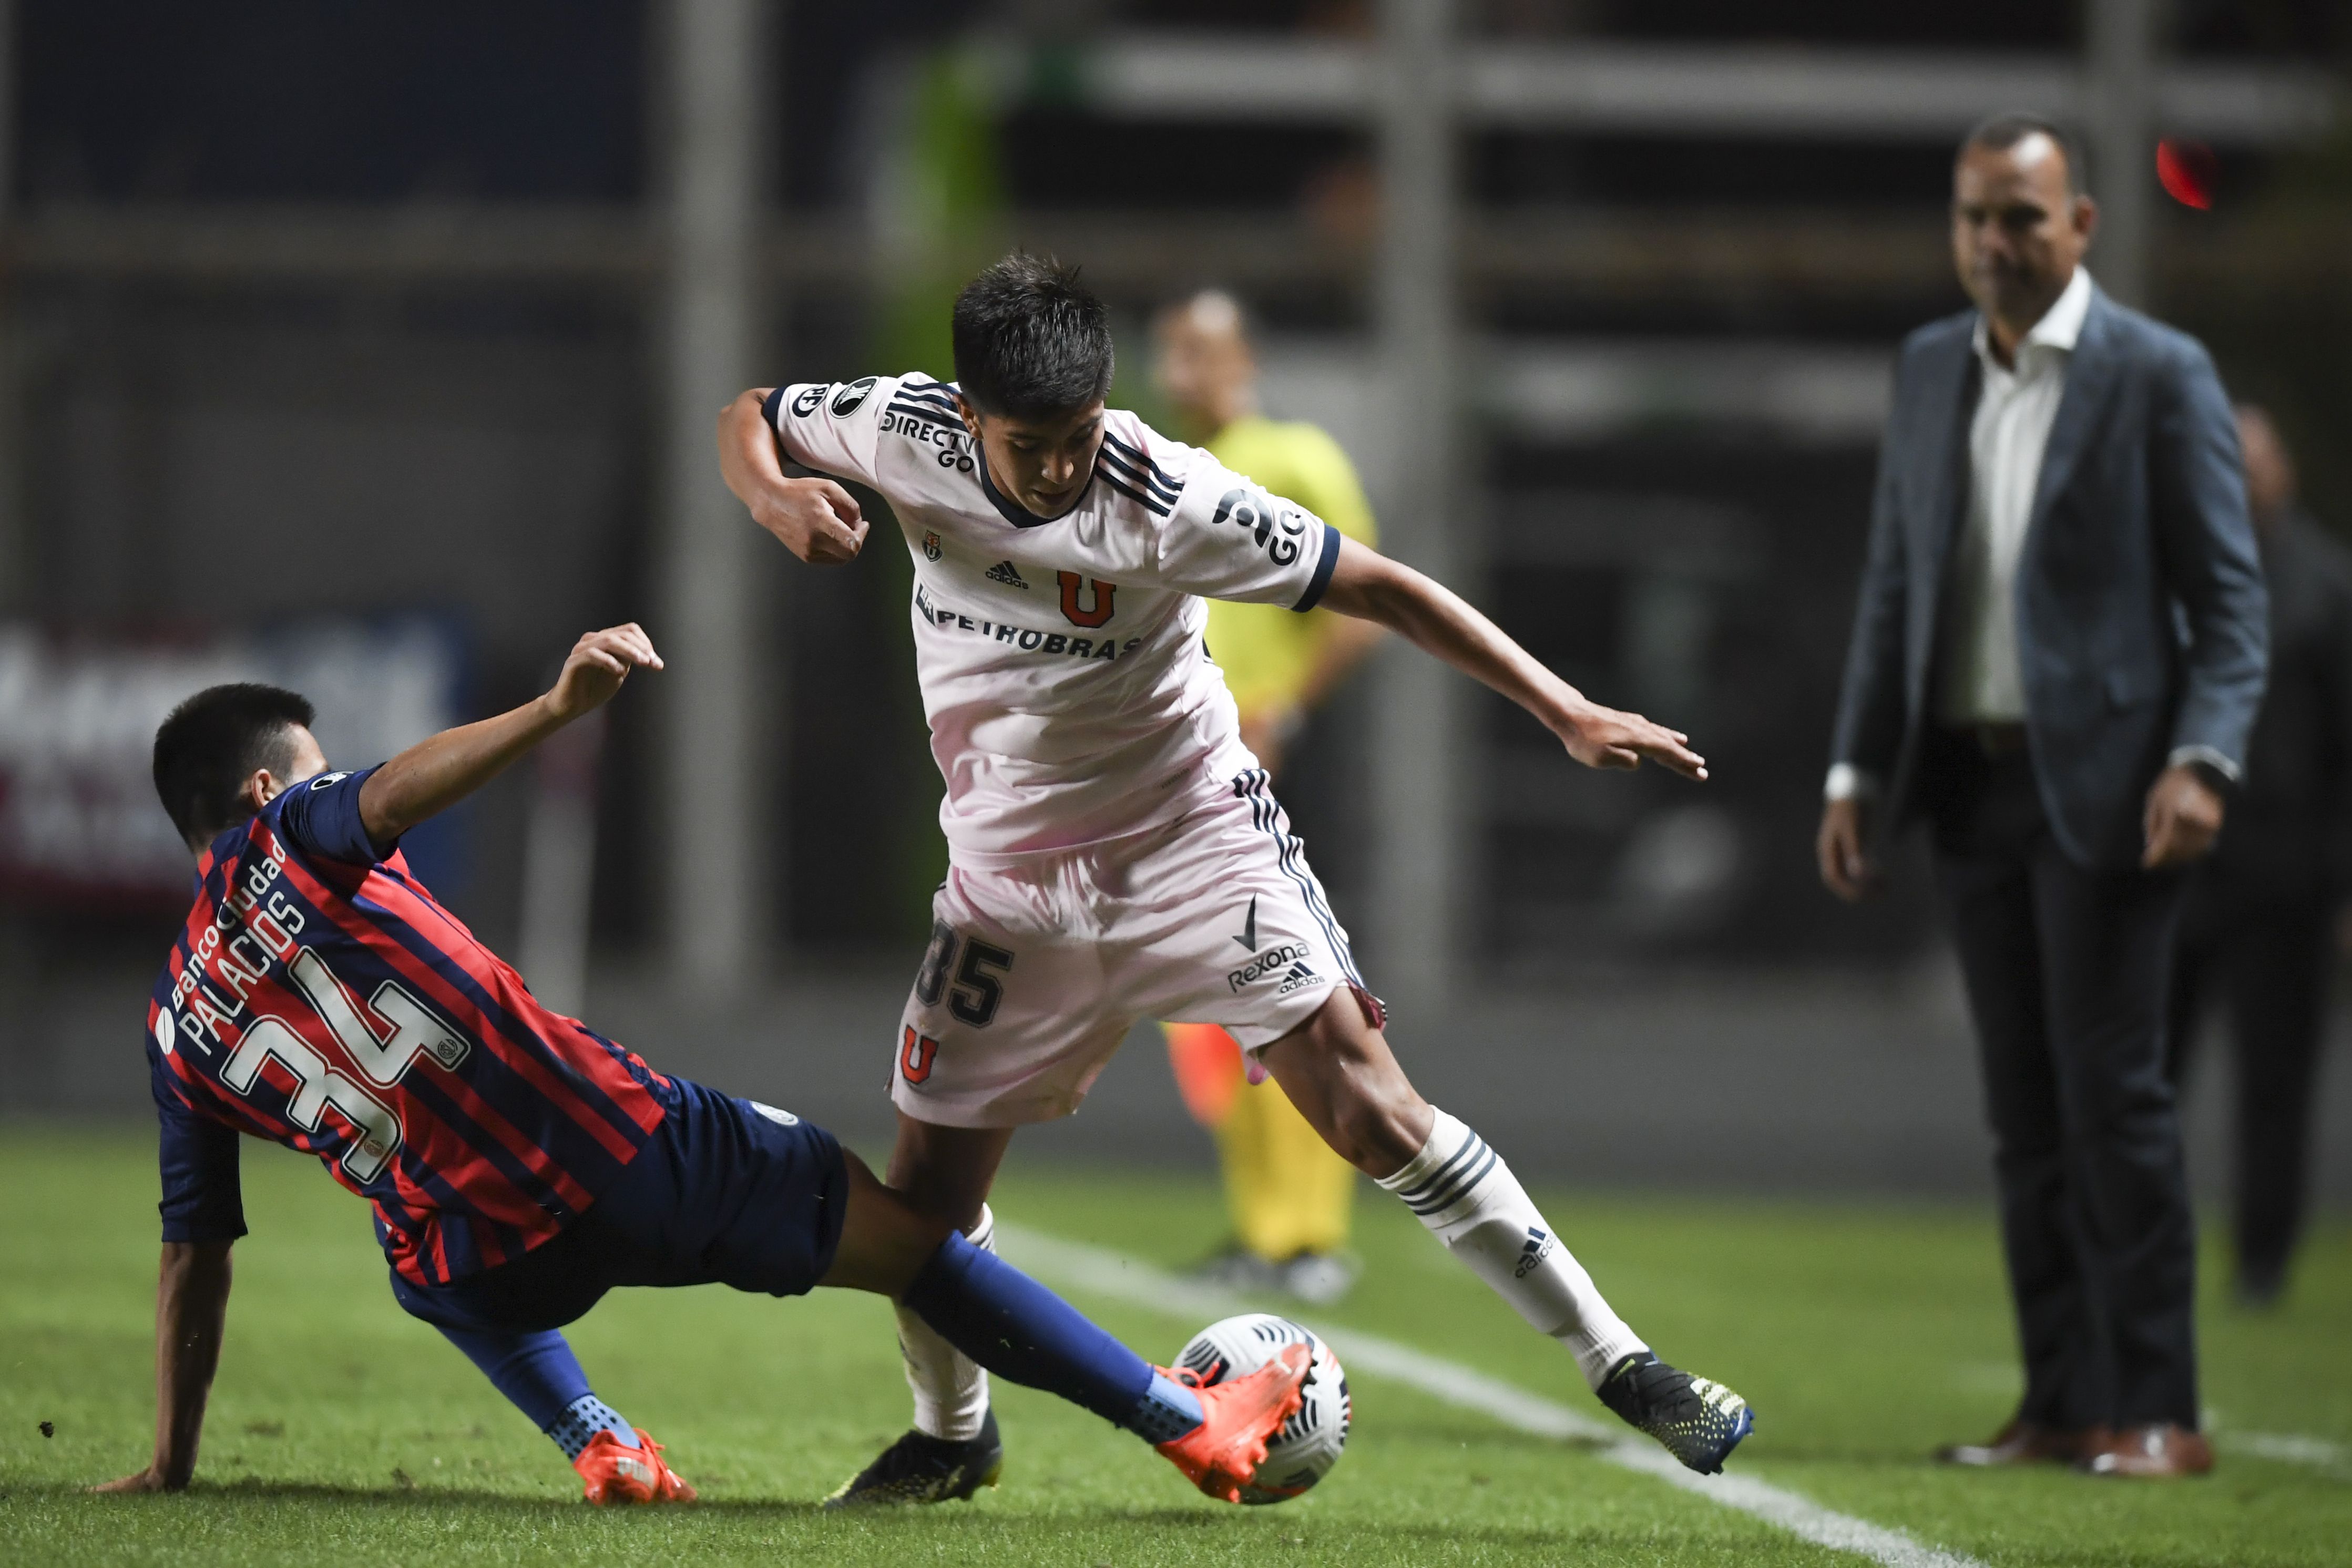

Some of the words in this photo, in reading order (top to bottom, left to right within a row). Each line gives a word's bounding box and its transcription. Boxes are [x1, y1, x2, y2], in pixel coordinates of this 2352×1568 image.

[880, 411, 976, 454] DIRECTV
[938, 450, 974, 472] GO
[1269, 510, 1306, 566] GO
[985, 570, 1029, 590] adidas
[1057, 570, 1117, 629] U
[171, 925, 220, 1013] Banco
[178, 890, 305, 1057] PALACIOS
[1227, 942, 1311, 993] Rexona
[1280, 976, 1326, 993] adidas
[219, 945, 472, 1185] 34
[901, 1024, 939, 1085] U
